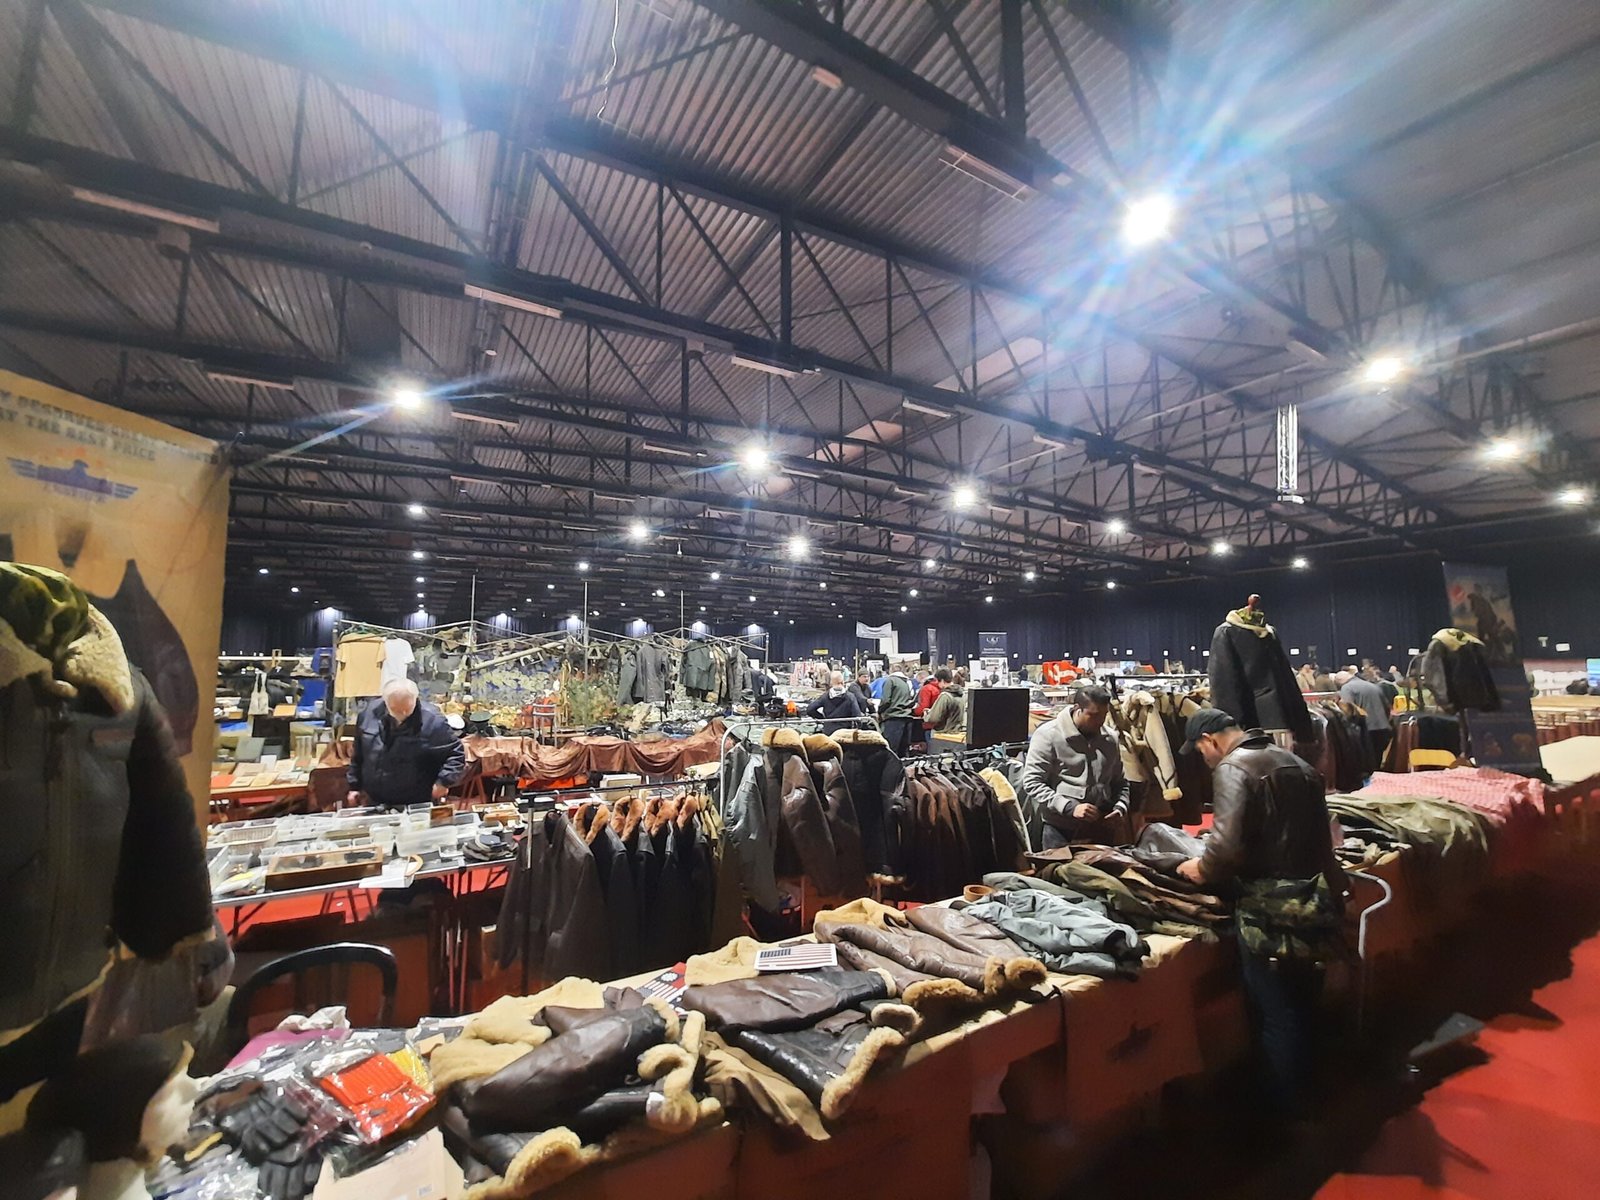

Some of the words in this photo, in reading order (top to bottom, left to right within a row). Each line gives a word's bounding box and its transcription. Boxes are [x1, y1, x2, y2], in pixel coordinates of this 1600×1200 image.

[24, 414, 60, 434] THE
[65, 426, 107, 448] BEST
[113, 438, 156, 461] PRICE
